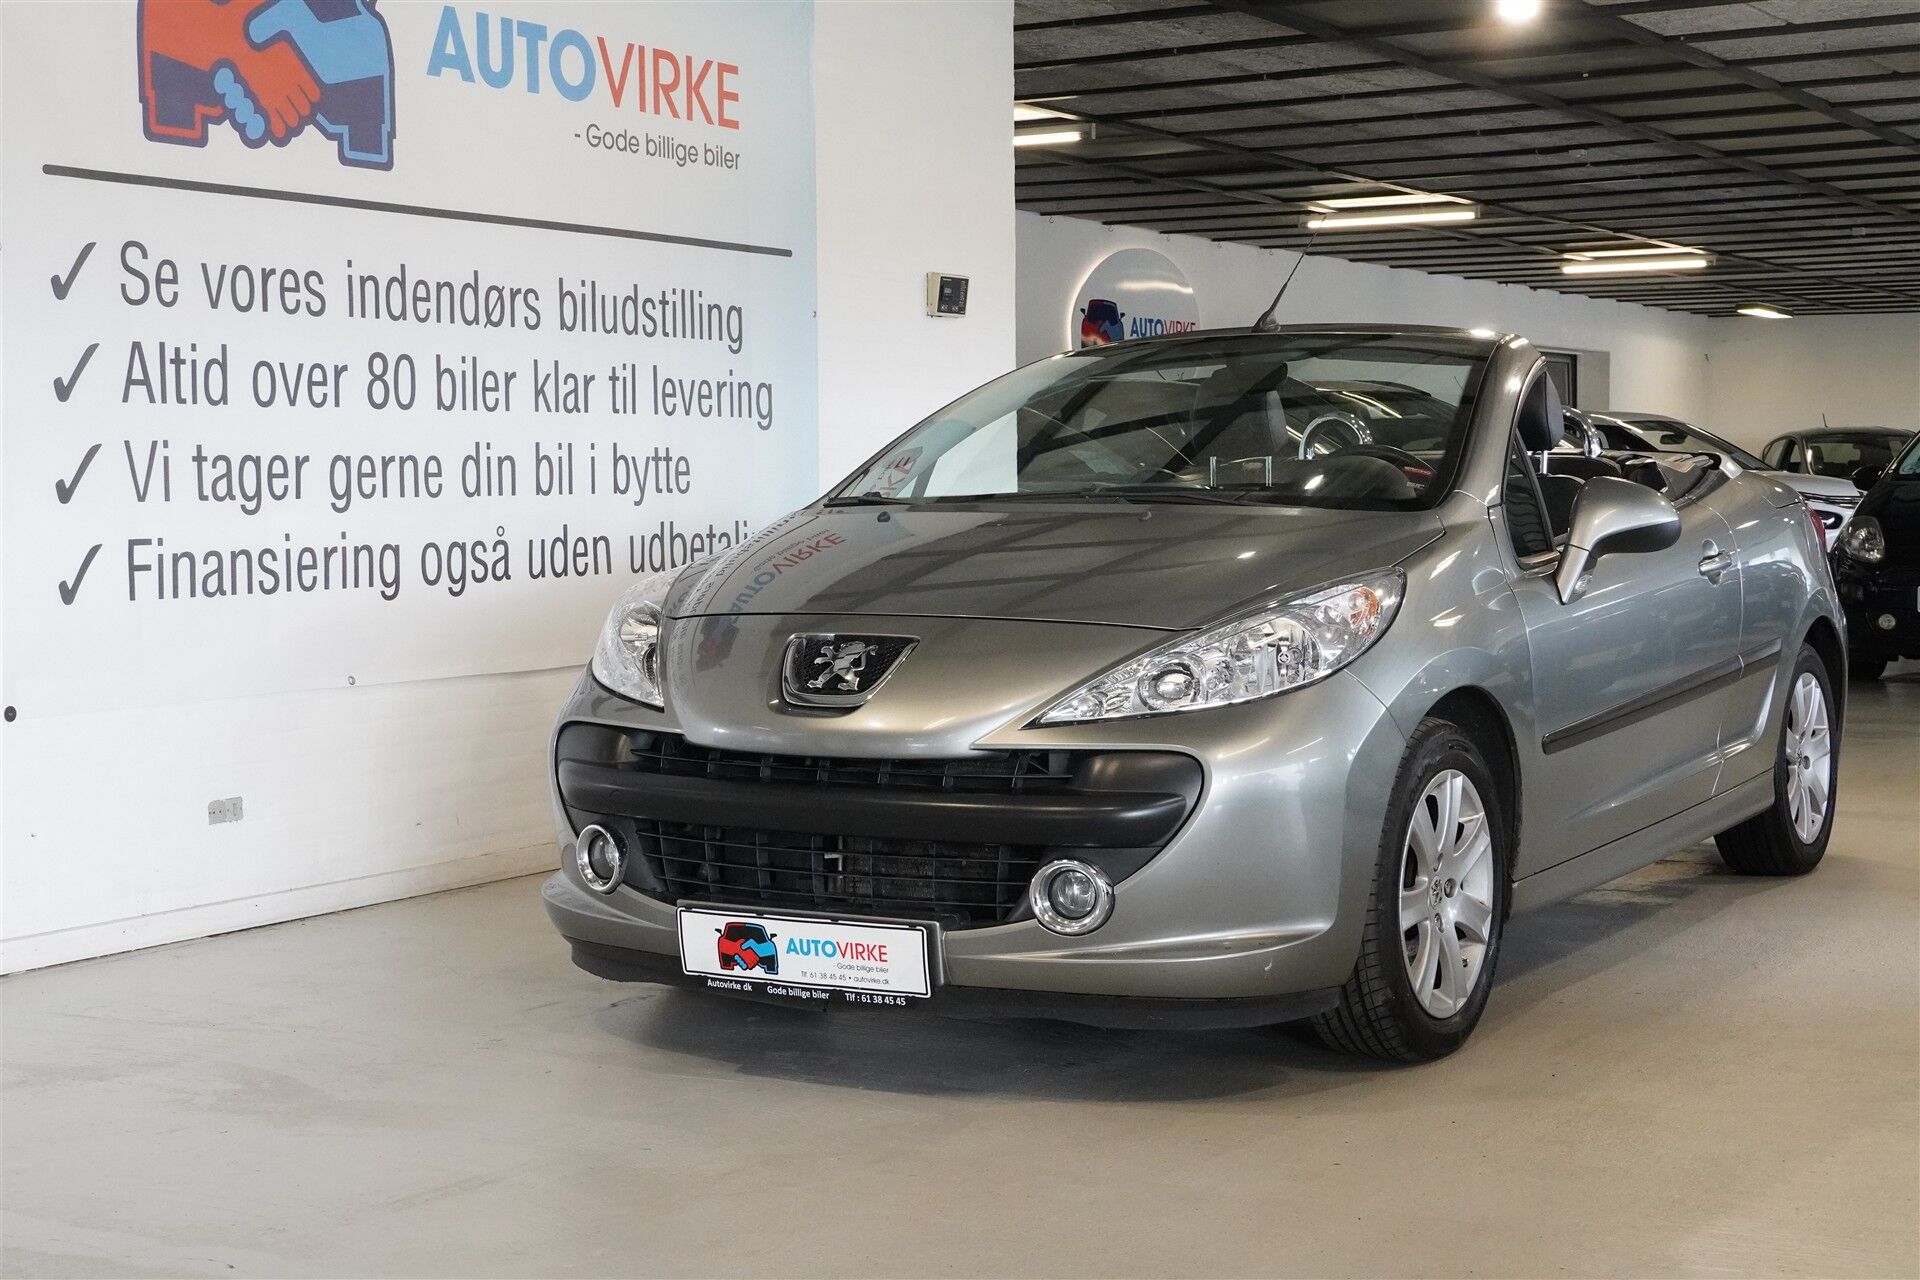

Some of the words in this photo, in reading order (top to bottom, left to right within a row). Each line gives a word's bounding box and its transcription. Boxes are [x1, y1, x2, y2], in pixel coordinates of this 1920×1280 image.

[426, 5, 740, 130] AUTOVIRKE
[586, 125, 640, 154] Gode
[645, 133, 699, 168] billige
[704, 146, 740, 170] biler
[120, 240, 179, 308] Se
[200, 263, 326, 318] vores
[347, 260, 541, 331] indendørs
[558, 278, 743, 354] biludstilling
[121, 341, 229, 407] Altid
[252, 360, 348, 408] over
[367, 352, 416, 411] 80
[435, 353, 517, 413] biler
[533, 360, 596, 414] klar
[608, 364, 637, 415] til
[652, 365, 774, 431] levering
[123, 440, 171, 503] Vi
[191, 444, 310, 516] tager
[329, 455, 443, 515] gerne
[461, 441, 517, 498] din
[535, 442, 574, 497] bil
[590, 442, 597, 495] i
[612, 443, 691, 507] bytte
[127, 531, 401, 602] Finansiering
[420, 525, 512, 598] også
[528, 524, 612, 578] uden
[786, 937, 888, 962] AUTOVIRKE
[707, 979, 741, 991] Autovirke
[743, 983, 753, 991] dk
[819, 972, 828, 980] 38
[829, 973, 837, 981] 45
[836, 962, 855, 971] Gode
[856, 965, 874, 973] billige
[767, 986, 787, 996] Gode
[788, 987, 811, 999] billige
[812, 991, 830, 1000] biler
[844, 993, 856, 1002] Tlf
[861, 994, 871, 1003] 61
[872, 996, 883, 1004] 38
[884, 997, 894, 1005] 45
[895, 998, 906, 1006] 45
